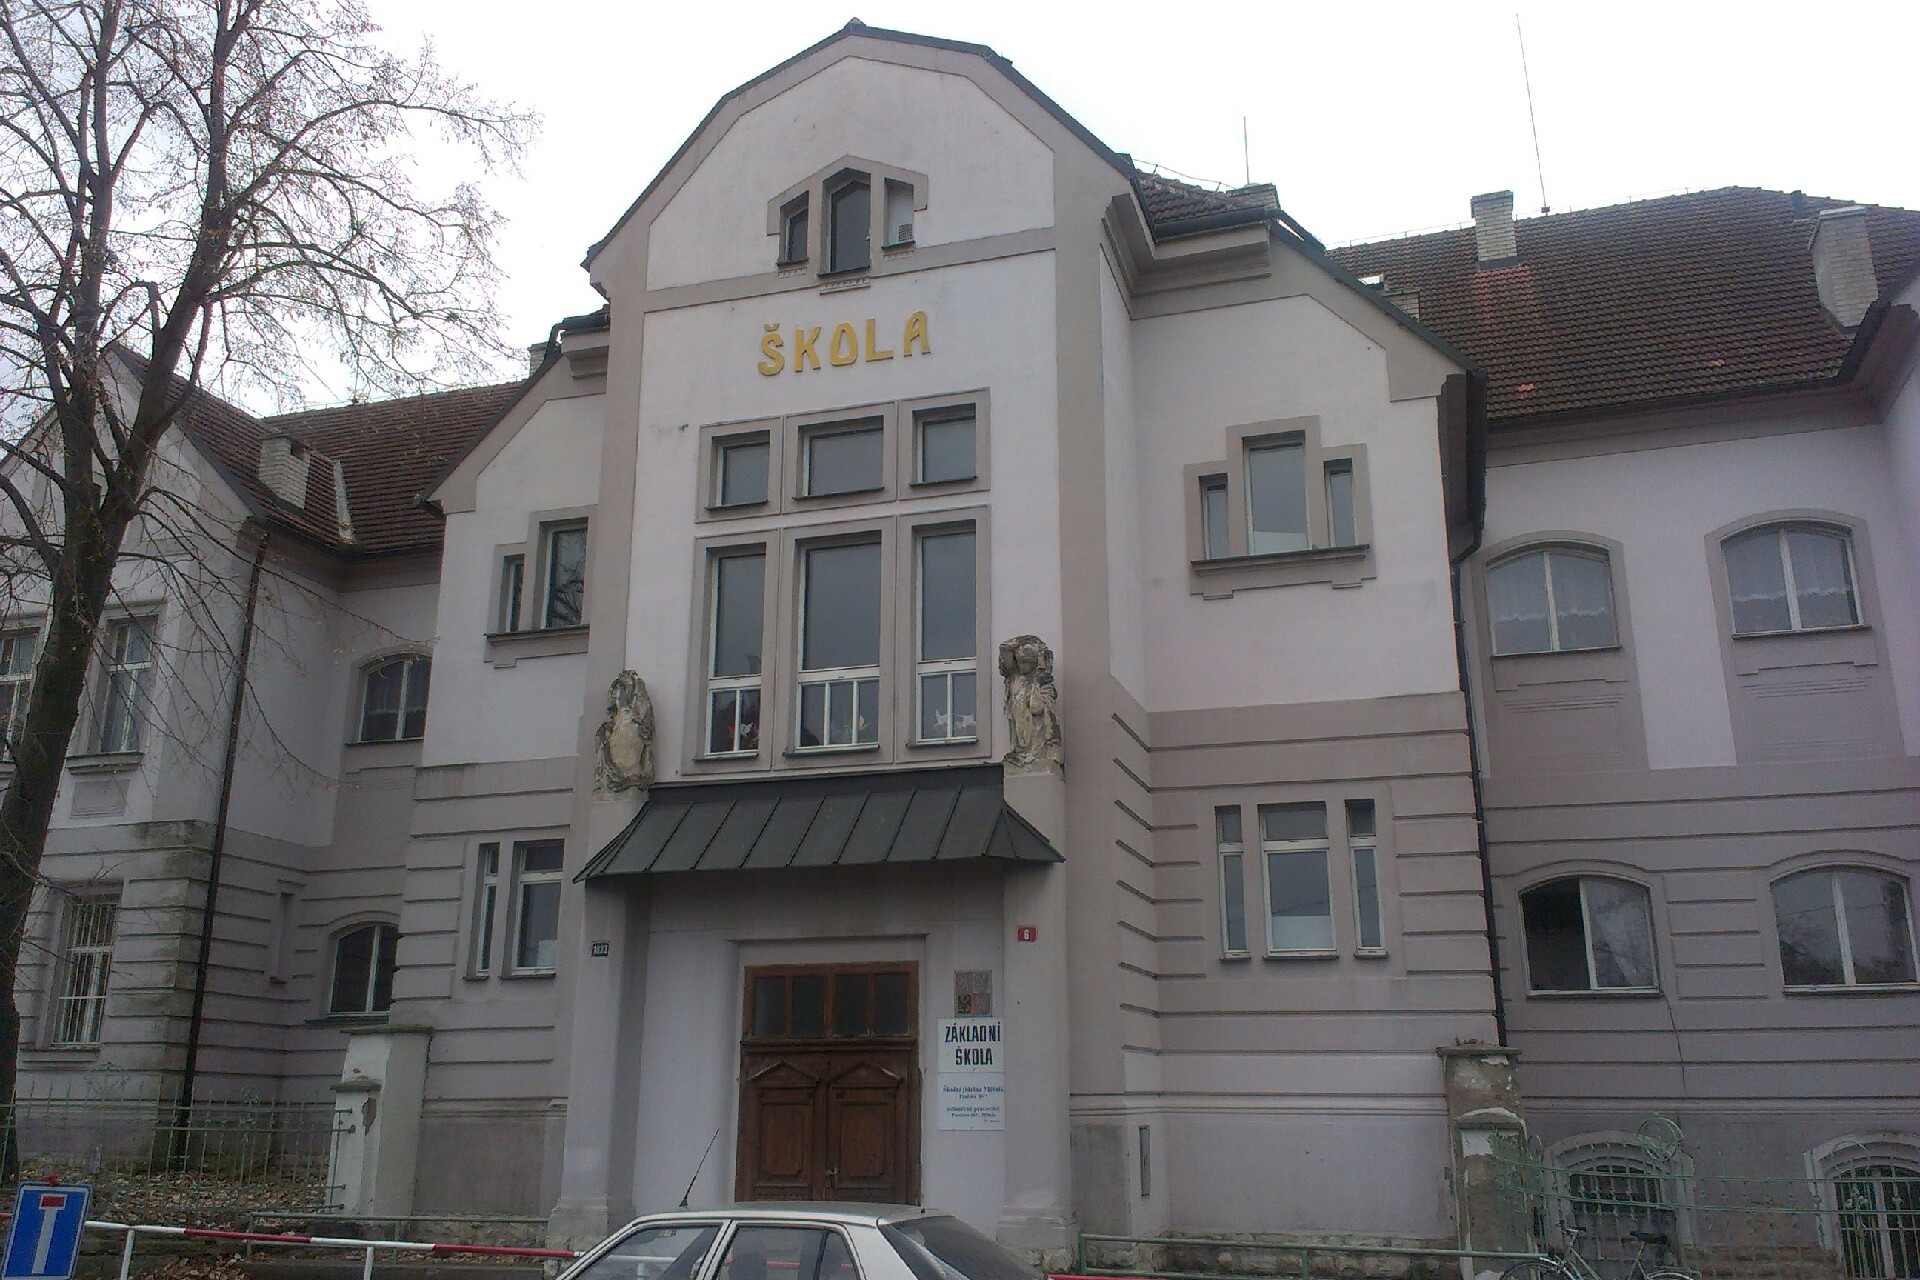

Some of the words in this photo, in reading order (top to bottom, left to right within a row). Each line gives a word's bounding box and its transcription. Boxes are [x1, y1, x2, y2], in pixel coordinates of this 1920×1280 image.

[757, 309, 931, 376] ŠKOLA
[1024, 929, 1030, 940] 6
[944, 1021, 1001, 1043] ZÁKLADNÍ
[955, 1045, 993, 1066] ŠKOLA
